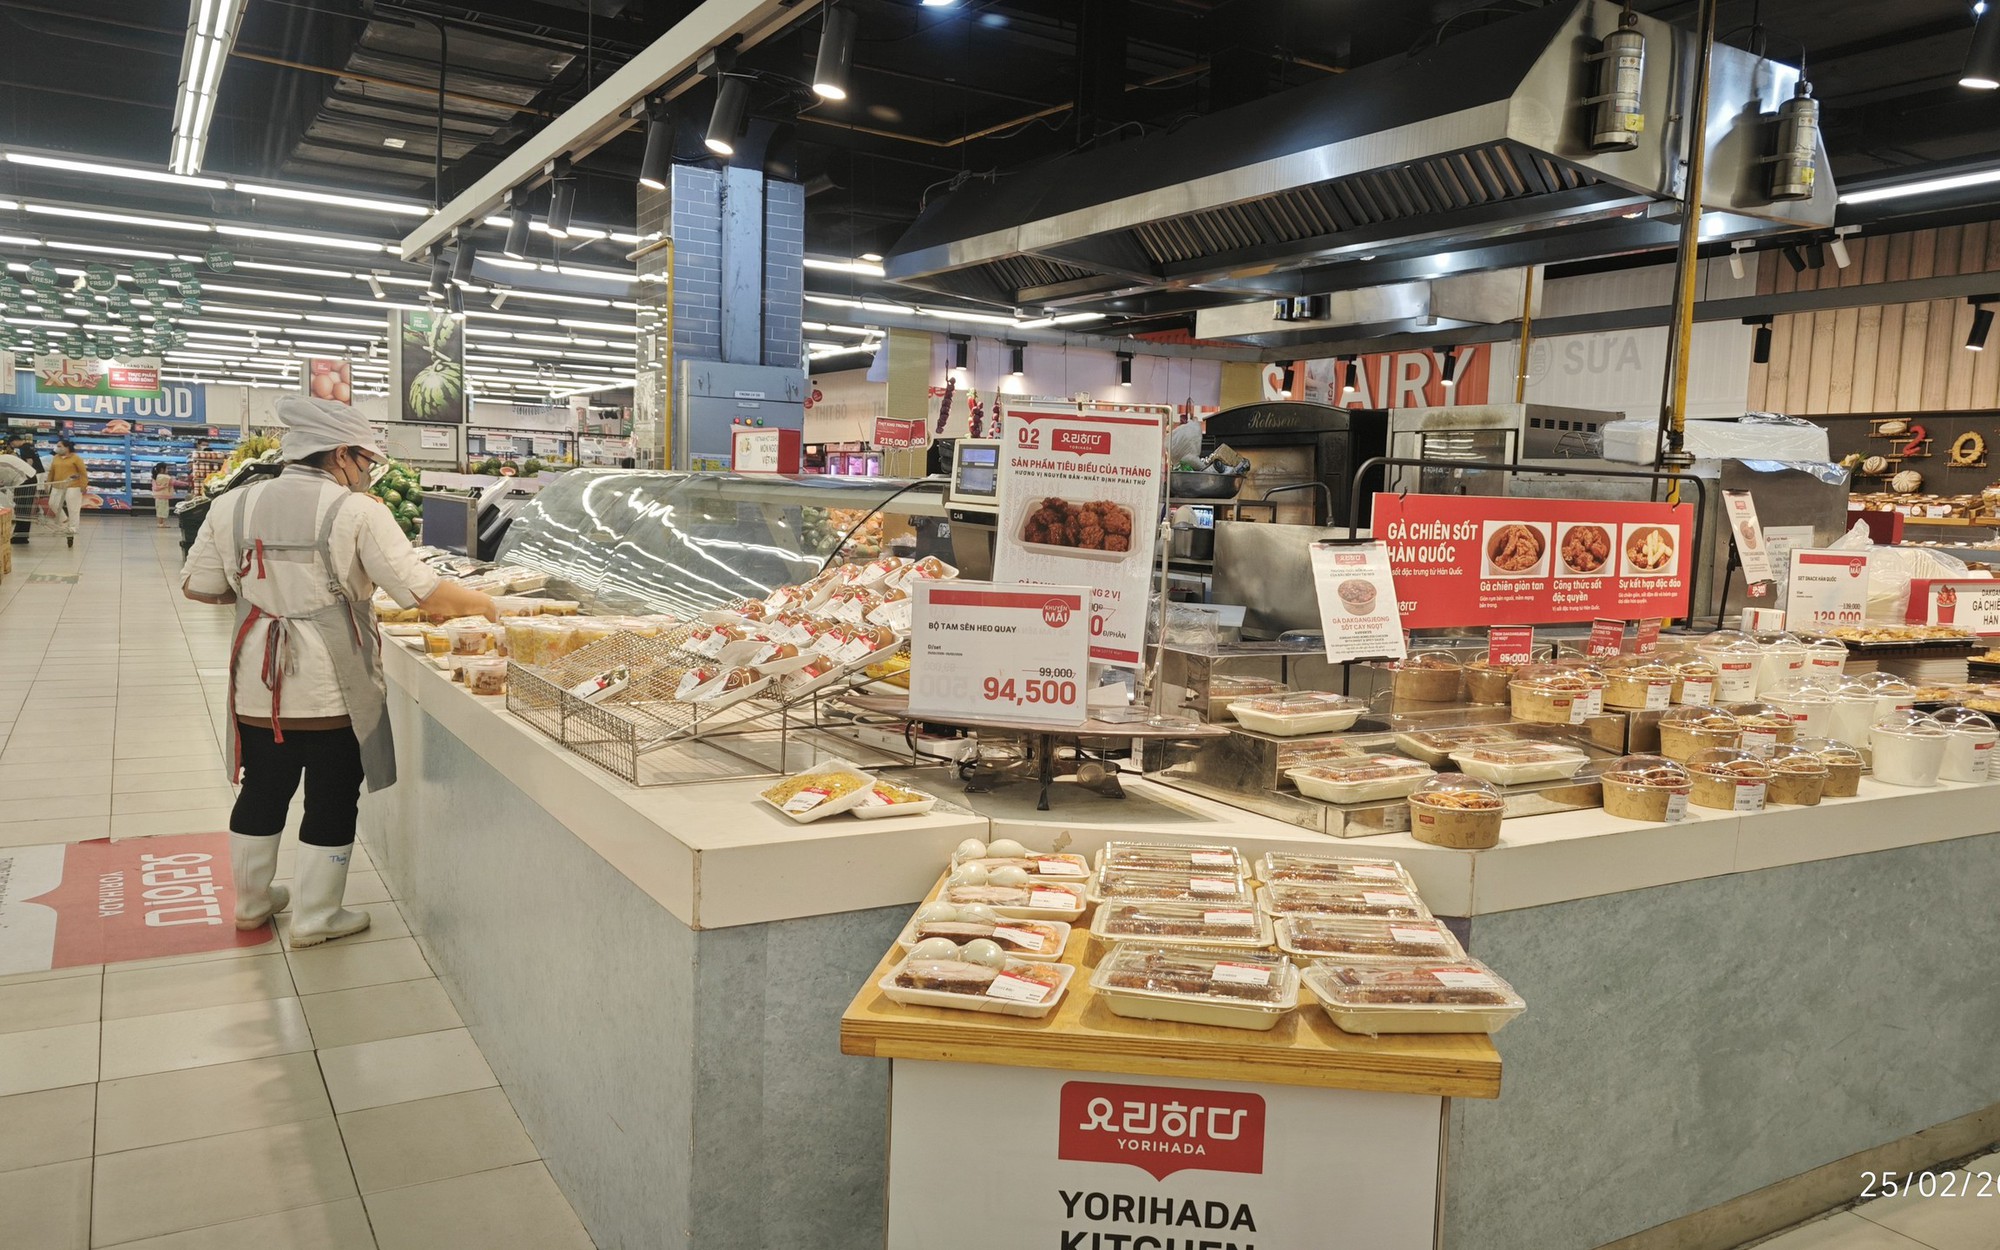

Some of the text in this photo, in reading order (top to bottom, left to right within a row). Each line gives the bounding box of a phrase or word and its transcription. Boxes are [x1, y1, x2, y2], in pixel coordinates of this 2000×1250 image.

[31, 276, 54, 284] FRESH
[1338, 347, 1475, 410] AIRY
[54, 387, 193, 418] SEAFOOD
[880, 437, 908, 447] 215,000
[1018, 427, 1040, 444] 02
[1061, 432, 1101, 445] 요리하다
[1011, 457, 1152, 478] SẢN PHẨM TIÊU BIỂU CỦA THÁNG
[1388, 518, 1478, 541] GÀ CHIÊN SỐT
[1388, 541, 1456, 564] HÀN QUỐC
[1437, 567, 1448, 576] Hàn
[1449, 566, 1463, 577] Quốc
[1480, 580, 1544, 592] Gà chiên giòn tan
[1553, 579, 1602, 591] Công thức sốt
[1618, 578, 1681, 590] Sự kết hợp độc đáo
[1111, 591, 1121, 601] VỊ
[1552, 591, 1588, 604] độc quyền
[1972, 598, 1983, 611] GÀ
[1983, 612, 1999, 625] HÀN
[928, 621, 1017, 634] BỘ TAM SÊN HEO QUAY
[1039, 667, 1073, 679] 99,000
[983, 676, 1077, 706] 94,500
[99, 871, 124, 918] YORIHADA
[141, 853, 223, 927] 요리하다
[1079, 1097, 1248, 1141] 요리하다
[1117, 1138, 1206, 1155] YORIHADA
[1058, 1190, 1257, 1232] YORIHADA
